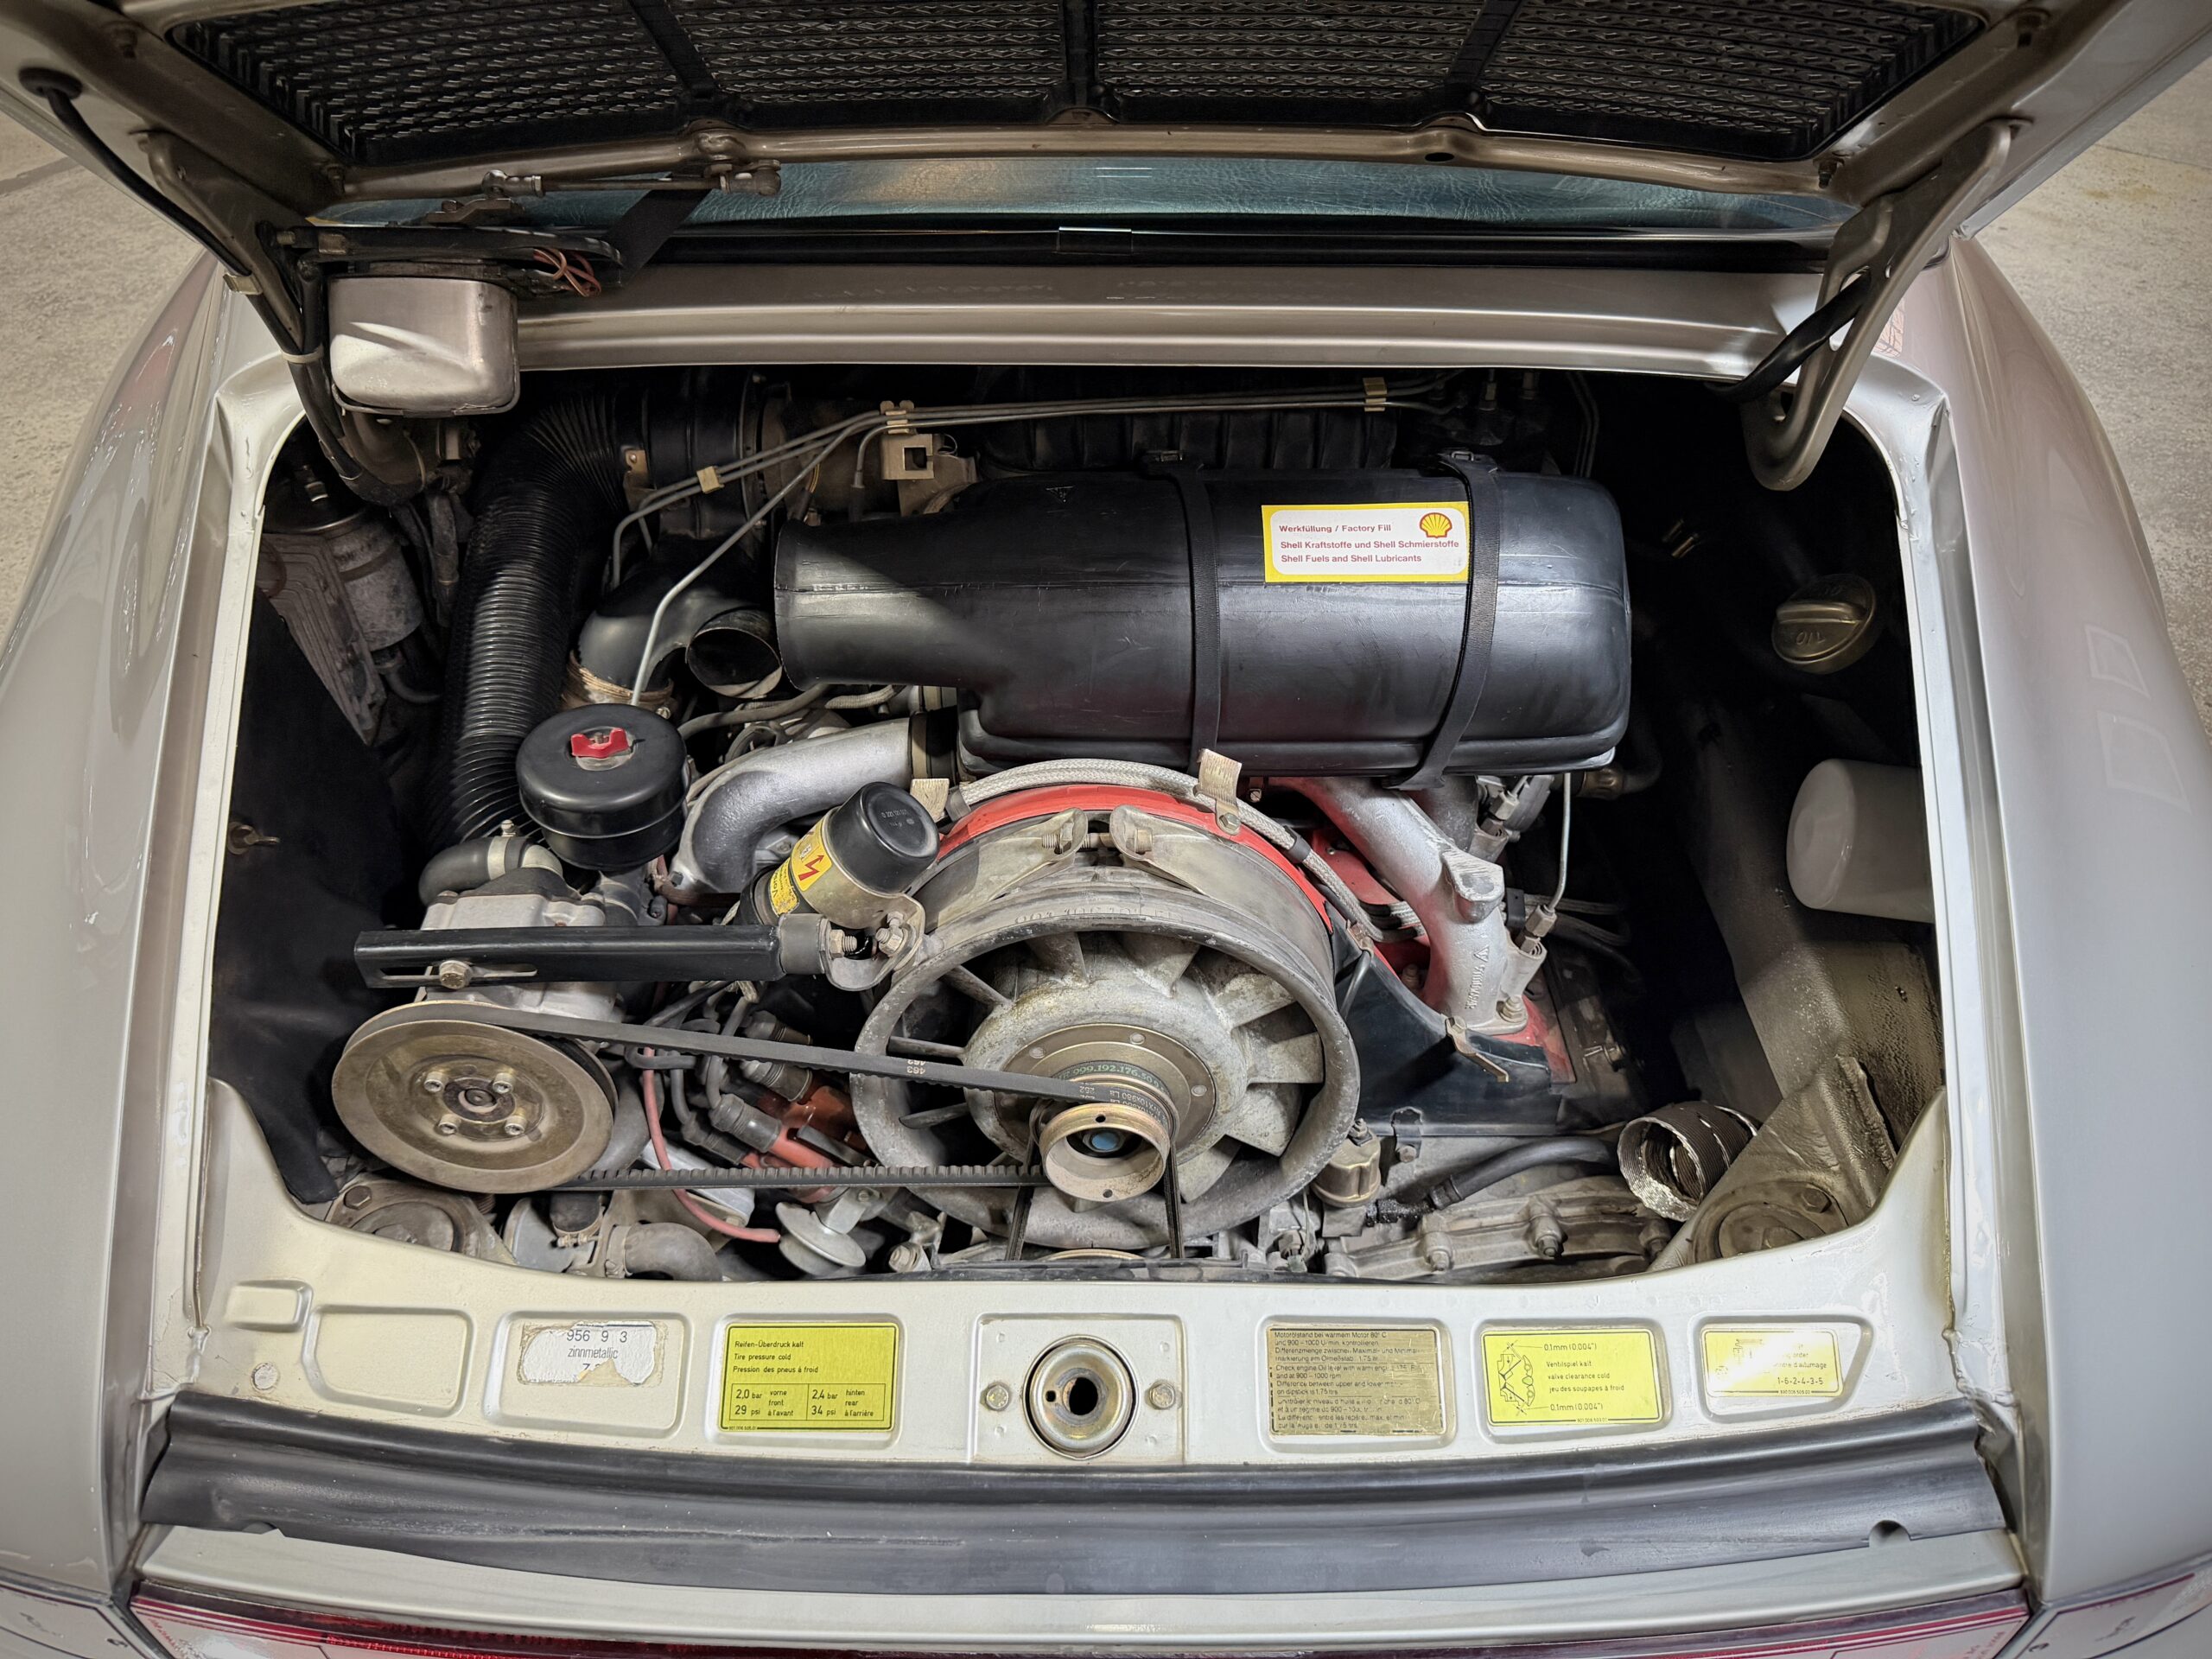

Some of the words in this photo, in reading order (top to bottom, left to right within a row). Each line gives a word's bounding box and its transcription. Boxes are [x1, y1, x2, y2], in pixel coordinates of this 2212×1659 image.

[1279, 524, 1332, 533] Werkfüllung
[1342, 524, 1376, 533] Factory
[906, 1066, 926, 1075] 463
[567, 1330, 591, 1342] 956
[601, 1331, 609, 1343] 9
[620, 1331, 628, 1343] 3
[734, 1339, 791, 1348] Reifen-Überdruck
[568, 1345, 620, 1359] zinnmetallic
[1777, 1376, 1824, 1385] 1-6-2-4-3-5
[735, 1389, 750, 1400] 2,0
[812, 1389, 825, 1400] 2,4
[734, 1405, 747, 1415] 29
[751, 1408, 761, 1417] psi
[811, 1405, 823, 1415] 34
[826, 1408, 836, 1417] psi
